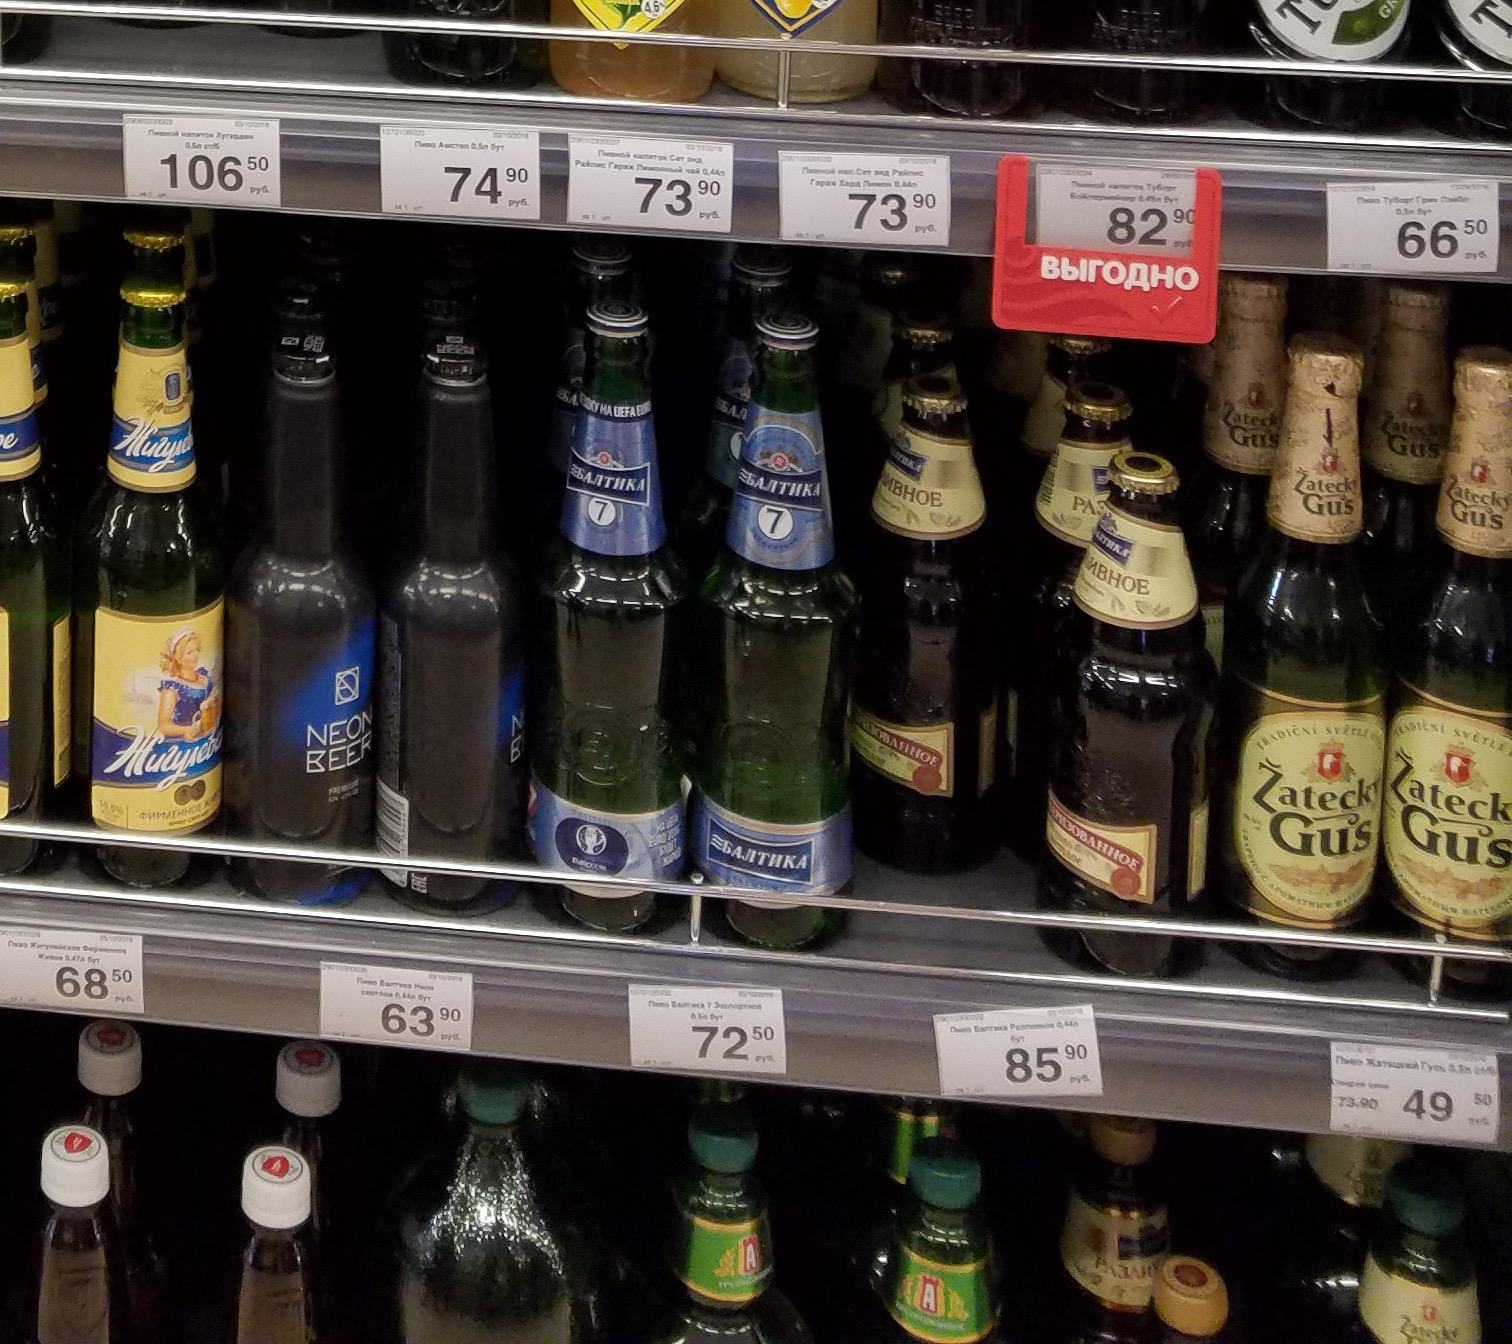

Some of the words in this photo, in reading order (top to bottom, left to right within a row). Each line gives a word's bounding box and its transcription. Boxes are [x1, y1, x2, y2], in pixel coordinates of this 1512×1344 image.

[444, 166, 502, 204] 74
[506, 168, 528, 182] 90
[635, 177, 692, 216] 73
[698, 181, 721, 195] 90
[1398, 220, 1458, 257] 66
[1464, 220, 1488, 236] 50
[1041, 256, 1198, 291] ВЫГОДНО
[579, 467, 646, 493] БАЛТИКА
[750, 473, 821, 500] БАЛТИКА
[1303, 494, 1354, 517] Gus
[723, 837, 809, 871] БАЛТИКА
[1270, 815, 1373, 858] Gus
